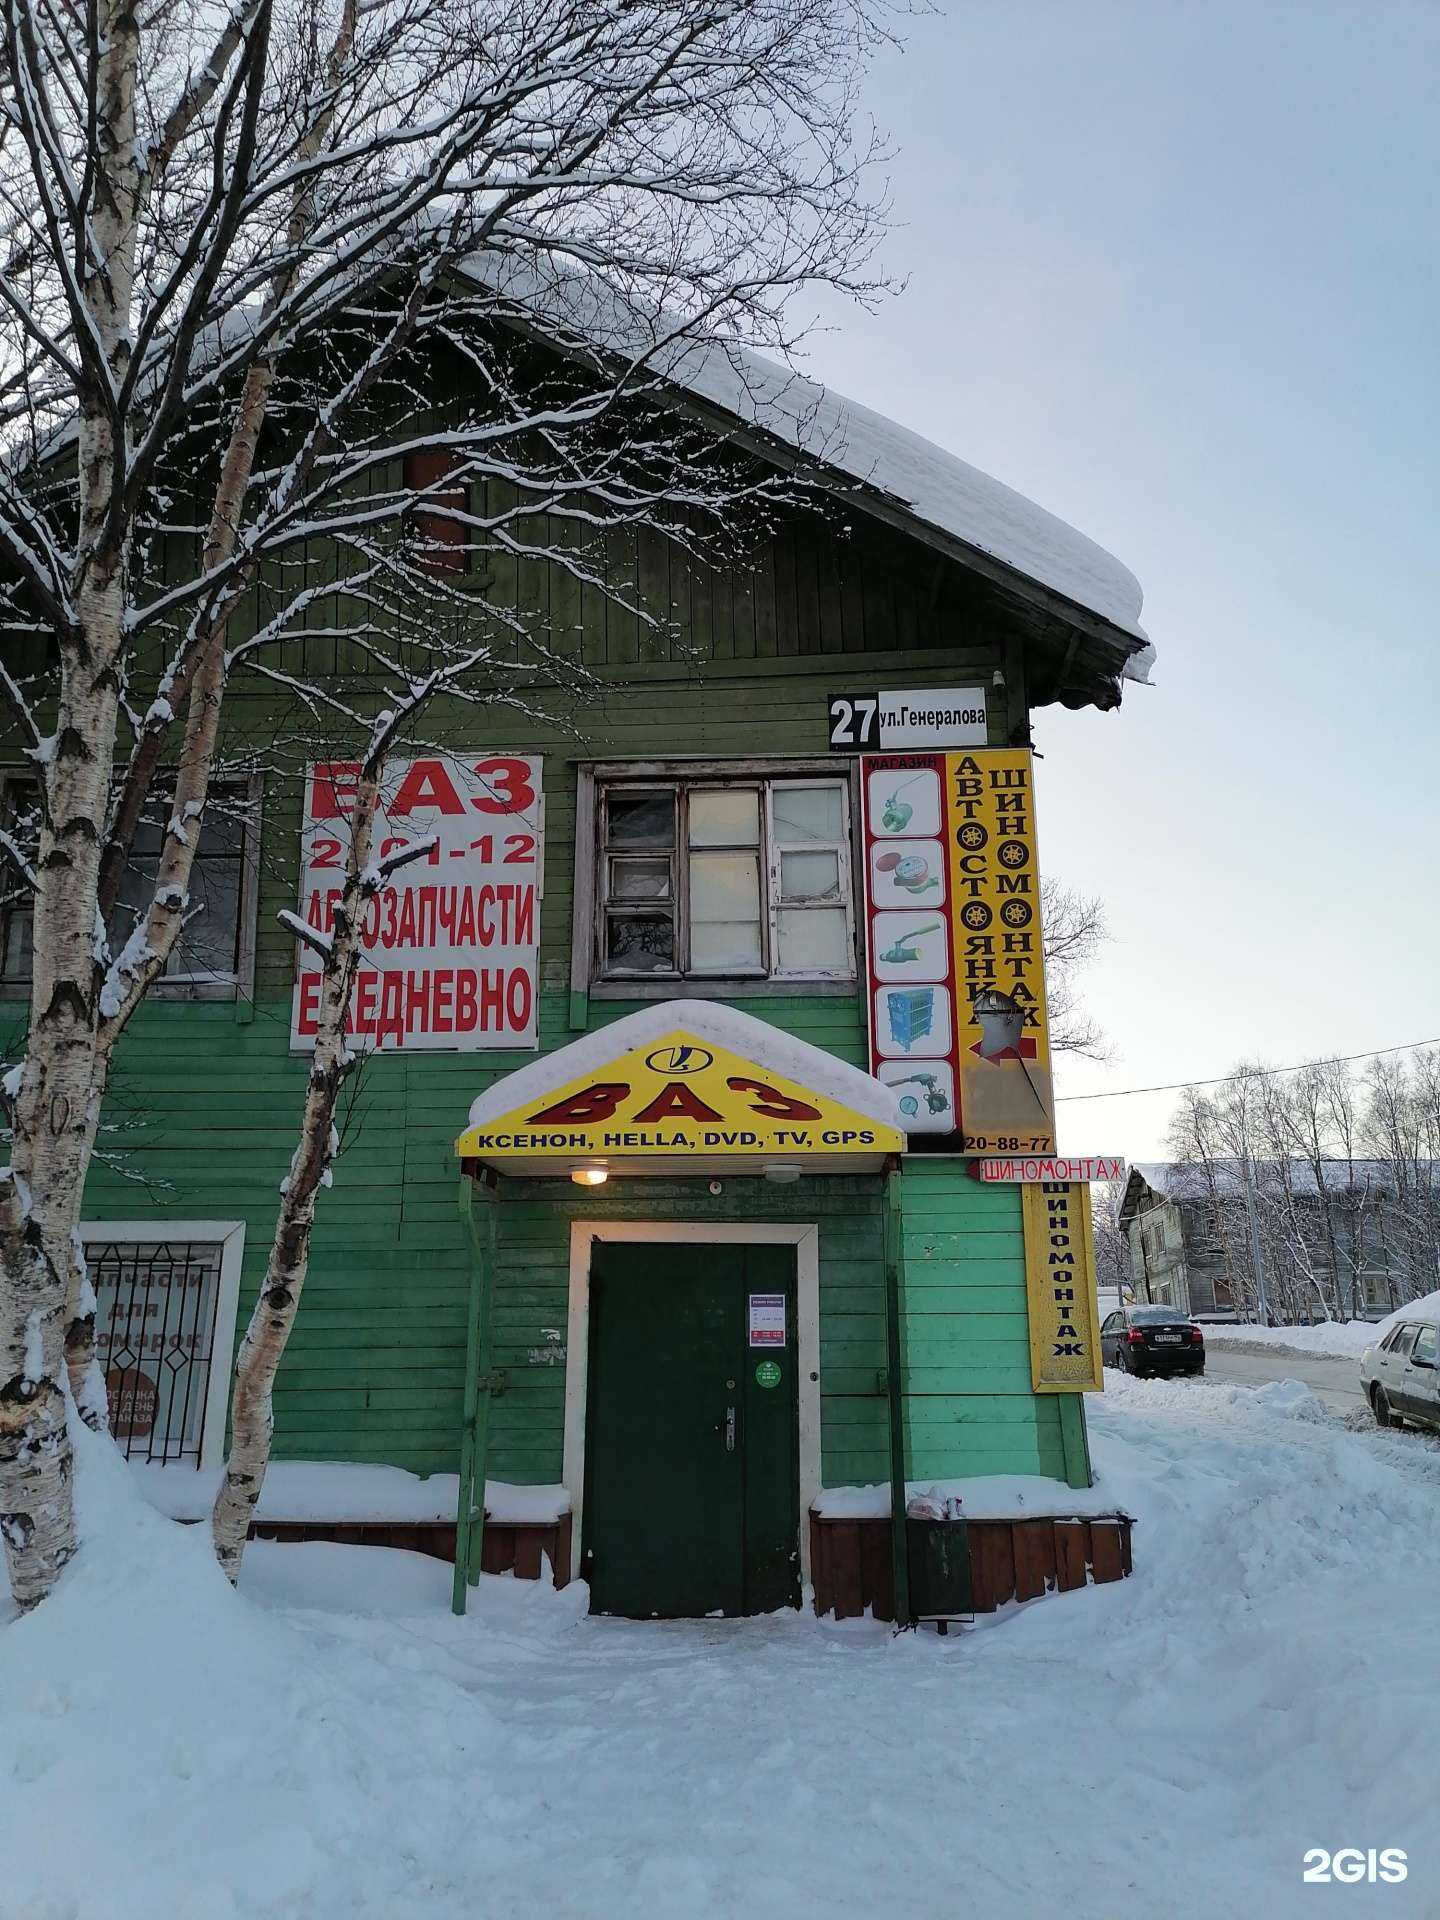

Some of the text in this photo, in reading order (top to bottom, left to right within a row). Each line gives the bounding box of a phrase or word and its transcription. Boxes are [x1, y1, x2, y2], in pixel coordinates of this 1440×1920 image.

[830, 700, 986, 743] 27 ул.Генералова
[867, 757, 937, 769] МАГАЗИН
[309, 758, 536, 819] ВАЗ
[308, 834, 536, 868] 21-12
[304, 884, 535, 950] АВОЗАПЧАСТИ
[298, 967, 532, 1047] ЕЕДНЕВНО
[523, 1077, 823, 1125] ВАЗ
[478, 1130, 875, 1150] КСЕНОН, HELLA, DVD, TV, GPS
[966, 1136, 1050, 1151] 20-88-77
[984, 1159, 1122, 1180] ШИНОМОНТАЖ
[92, 1273, 202, 1288] апчасти
[1043, 1182, 1085, 1356] ШИНОМОНТАЖ
[108, 1303, 159, 1320] для
[97, 1333, 202, 1352] омарок
